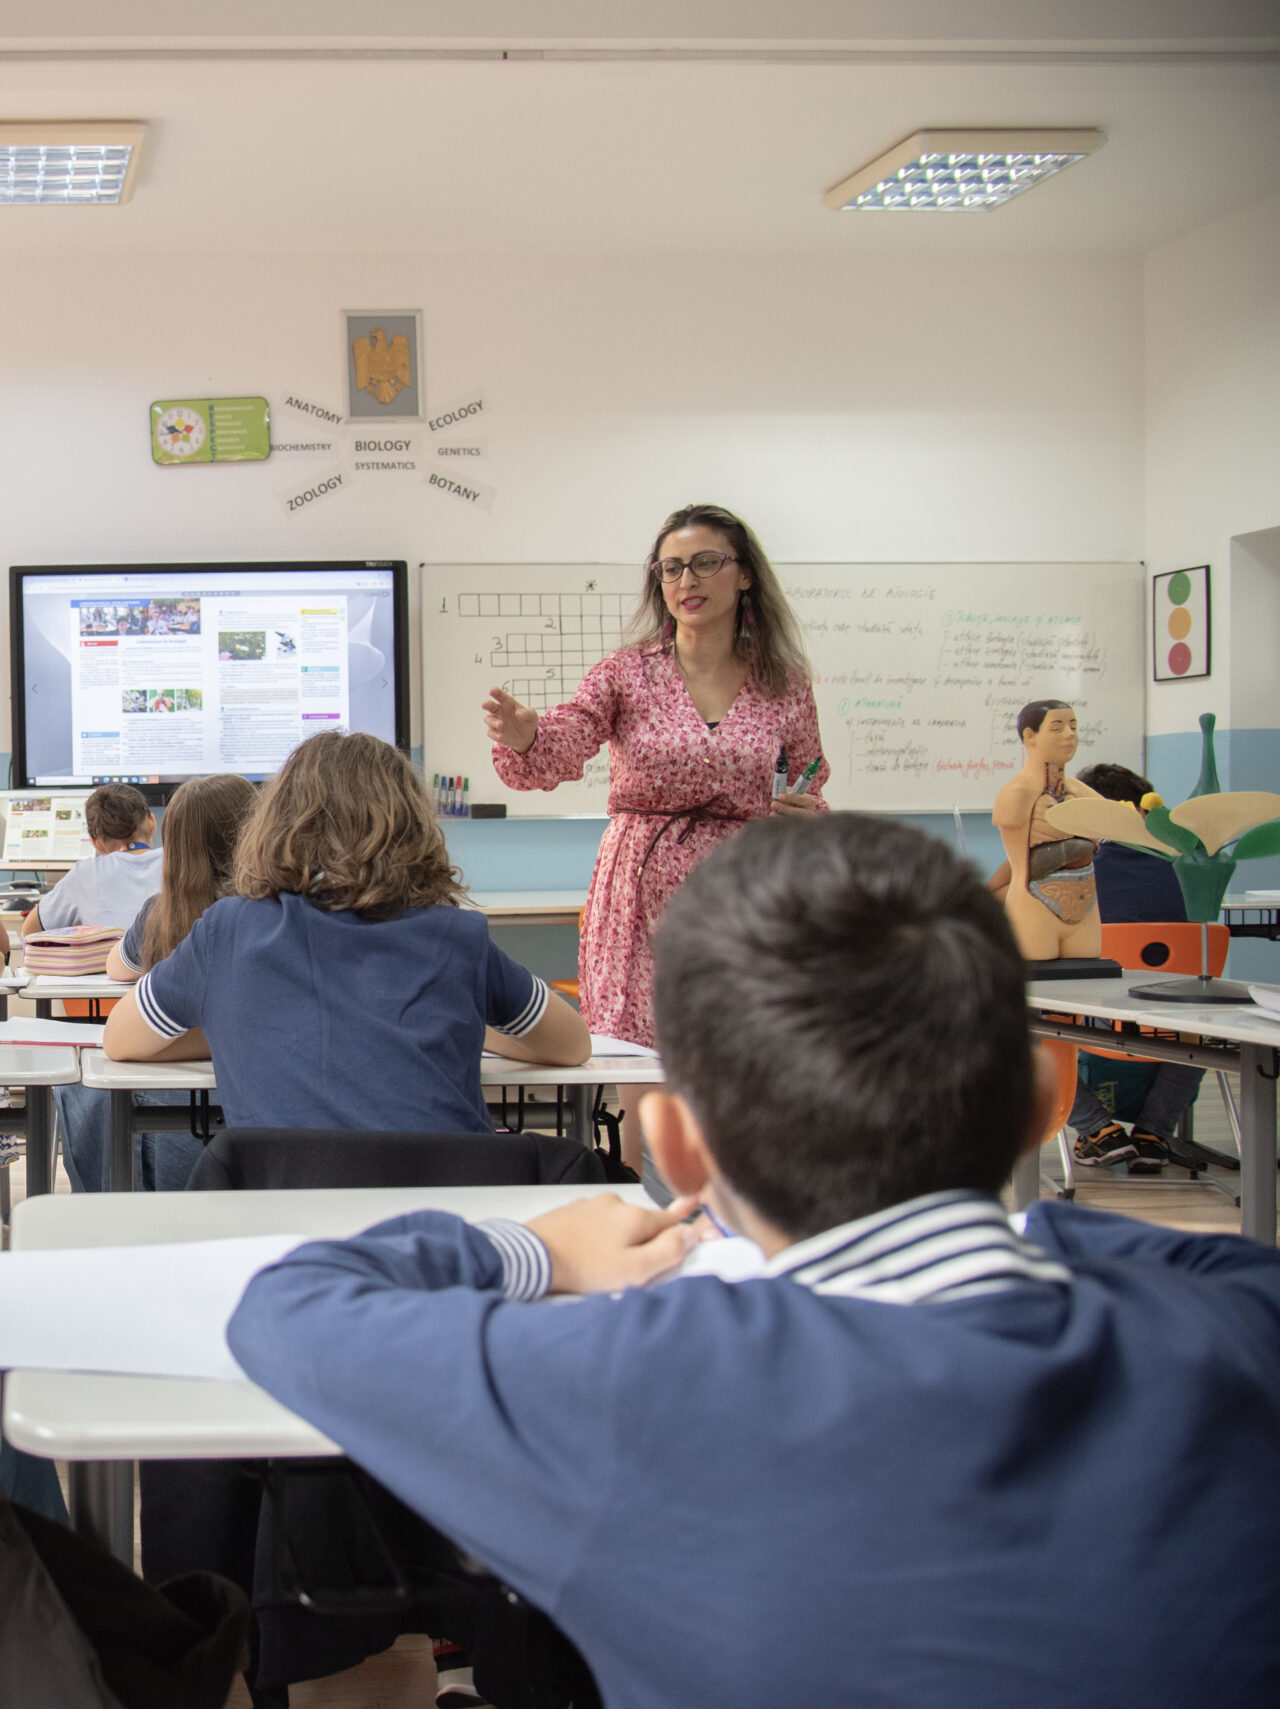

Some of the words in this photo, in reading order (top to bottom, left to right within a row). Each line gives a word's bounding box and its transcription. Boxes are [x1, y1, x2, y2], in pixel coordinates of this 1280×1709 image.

[284, 396, 345, 425] ANATOMY
[428, 399, 486, 431] ECOLOGY
[354, 440, 412, 452] BIOLOGY
[437, 447, 481, 457] GENETICS
[354, 461, 416, 471] SYSTEMATICS
[286, 473, 345, 512] ZOOLOGY
[428, 473, 481, 503] BOTANY
[439, 596, 448, 613] 1
[544, 618, 556, 629] 2
[491, 636, 503, 650] 3
[474, 653, 482, 665] 4
[545, 668, 556, 679] 5
